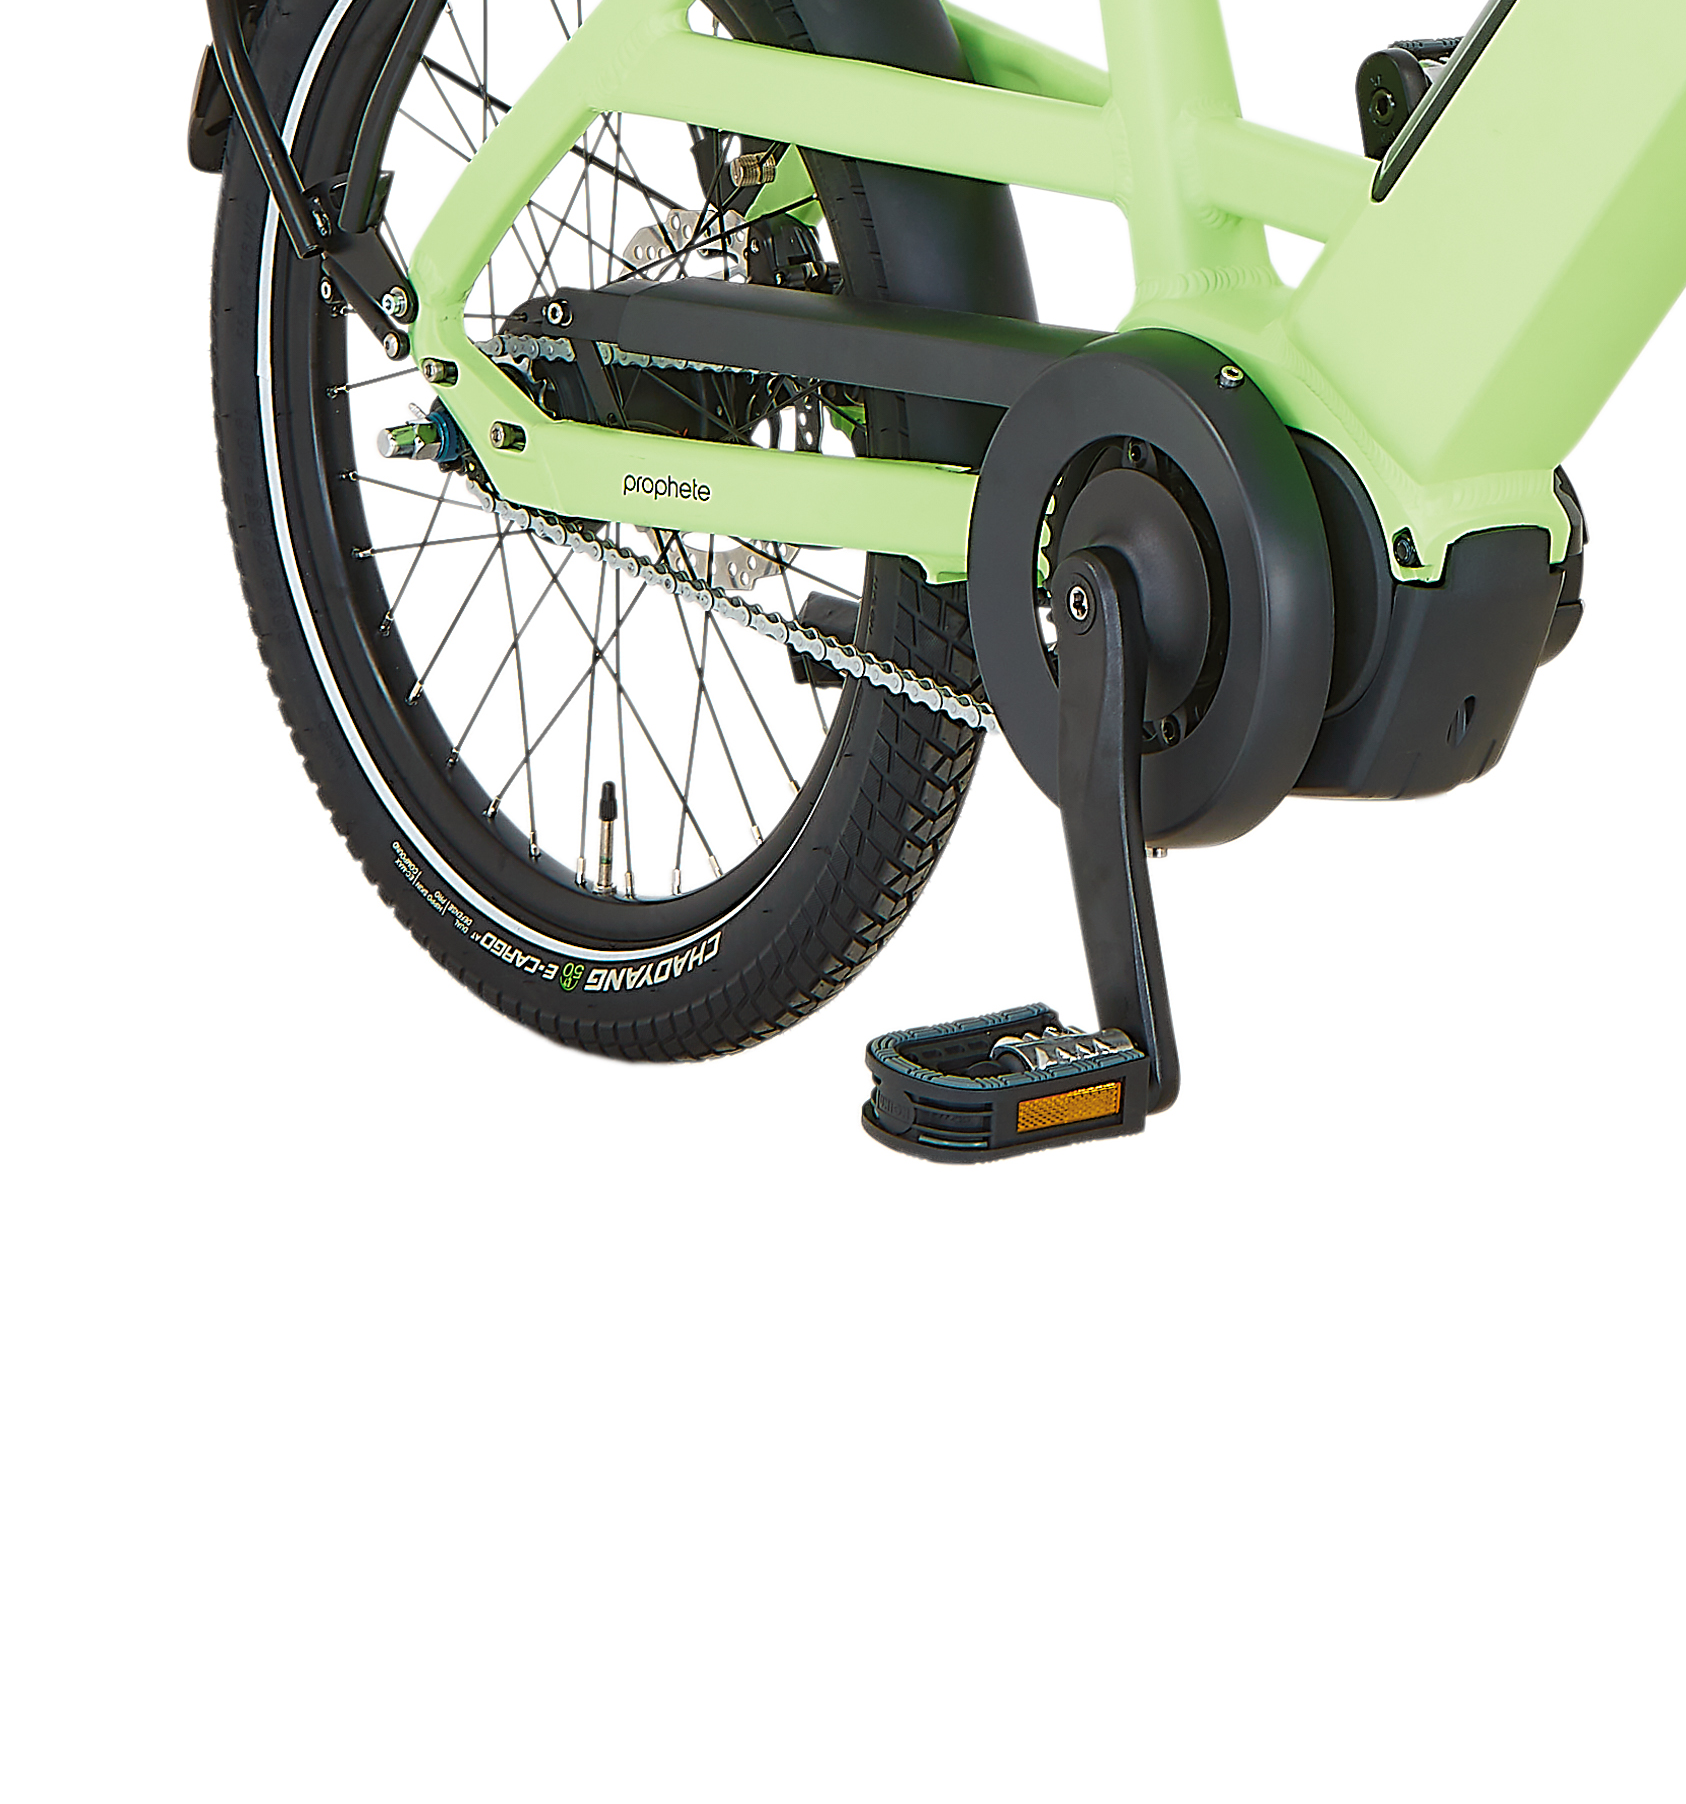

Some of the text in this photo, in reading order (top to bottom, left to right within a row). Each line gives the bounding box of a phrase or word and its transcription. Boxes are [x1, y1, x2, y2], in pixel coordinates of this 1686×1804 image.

[623, 474, 711, 502] prophete
[434, 891, 447, 905] PRO
[454, 918, 469, 934] DUAL
[470, 931, 560, 980] E-CARGO AT
[583, 931, 722, 992] CHAOYANG
